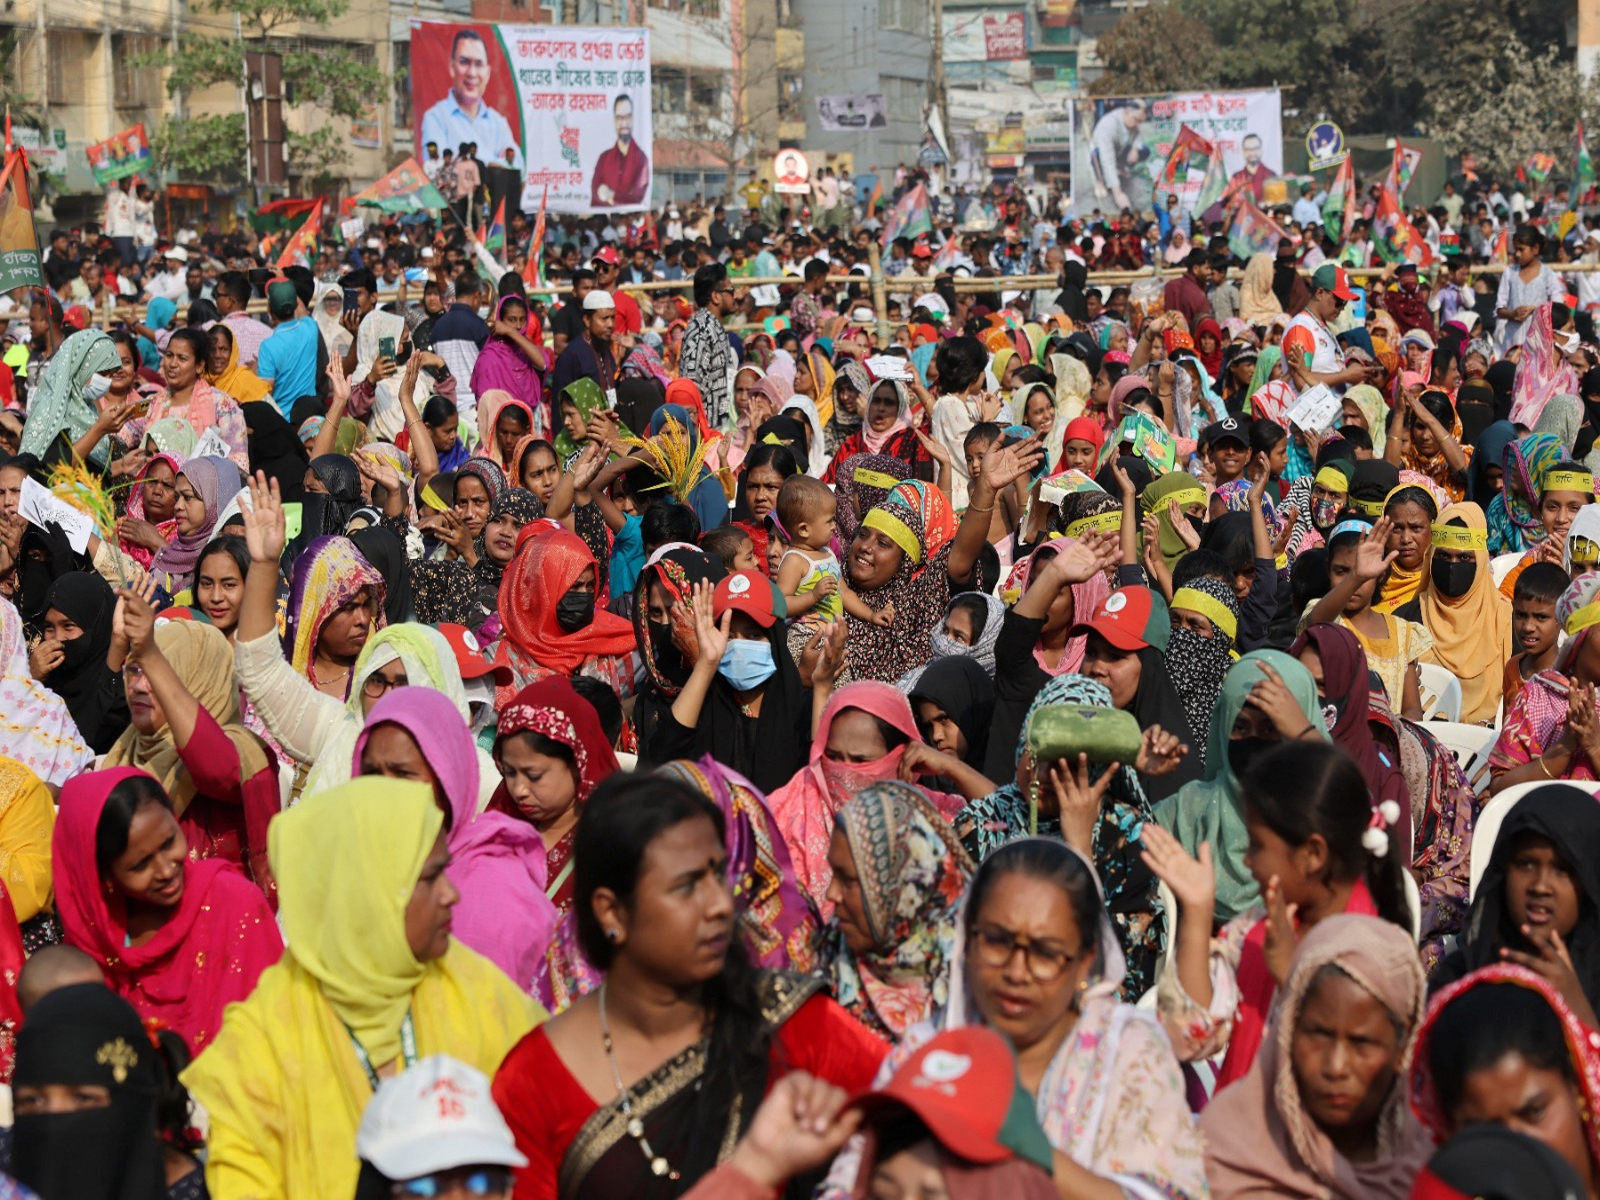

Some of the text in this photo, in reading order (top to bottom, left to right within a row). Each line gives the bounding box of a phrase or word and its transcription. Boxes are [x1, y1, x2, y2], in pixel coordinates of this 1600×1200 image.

[582, 42, 614, 62] প্রথম
[619, 37, 646, 61] ভোট
[519, 69, 552, 87] ধানের
[556, 62, 593, 87] শীষের
[570, 94, 609, 112] রহমান
